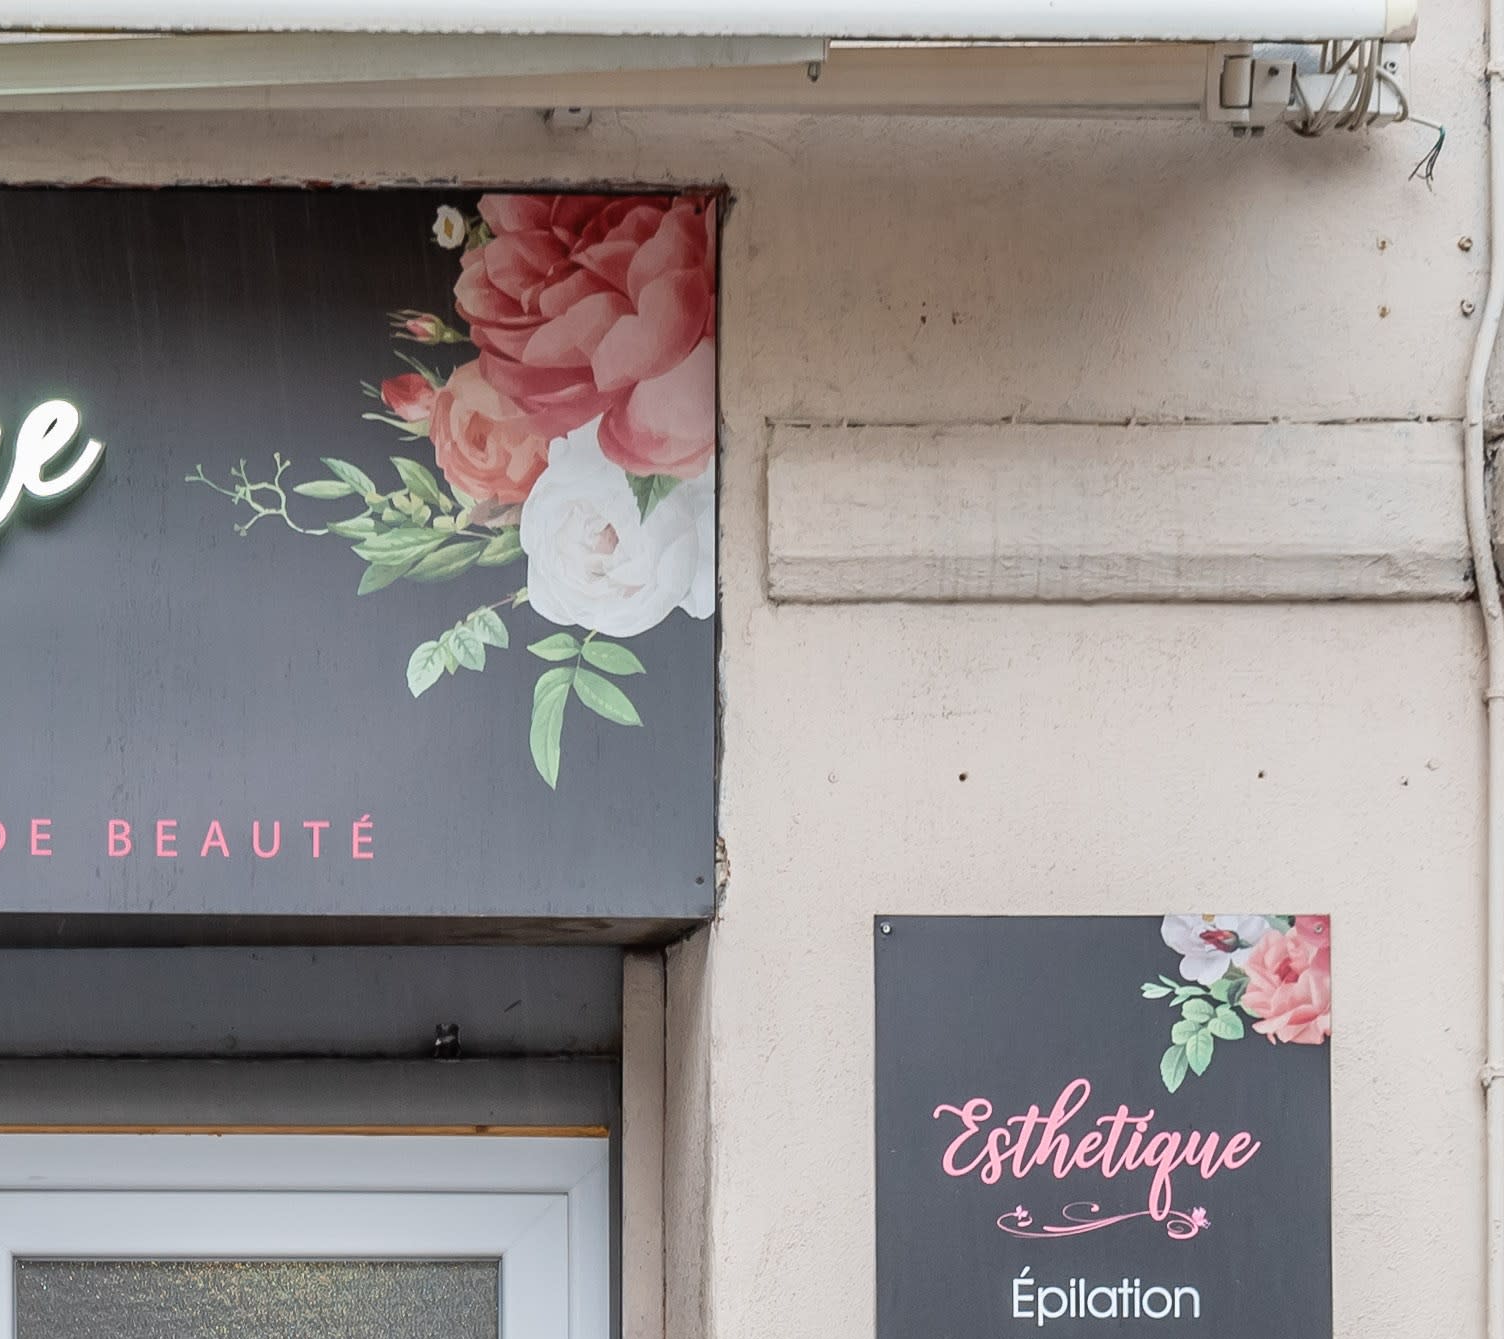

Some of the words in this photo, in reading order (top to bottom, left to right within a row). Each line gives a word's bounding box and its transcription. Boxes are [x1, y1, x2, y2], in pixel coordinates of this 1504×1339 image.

[108, 814, 374, 859] BEAUTÉ
[933, 1078, 1261, 1222] Esthetique
[1012, 1265, 1200, 1327] Épilation
